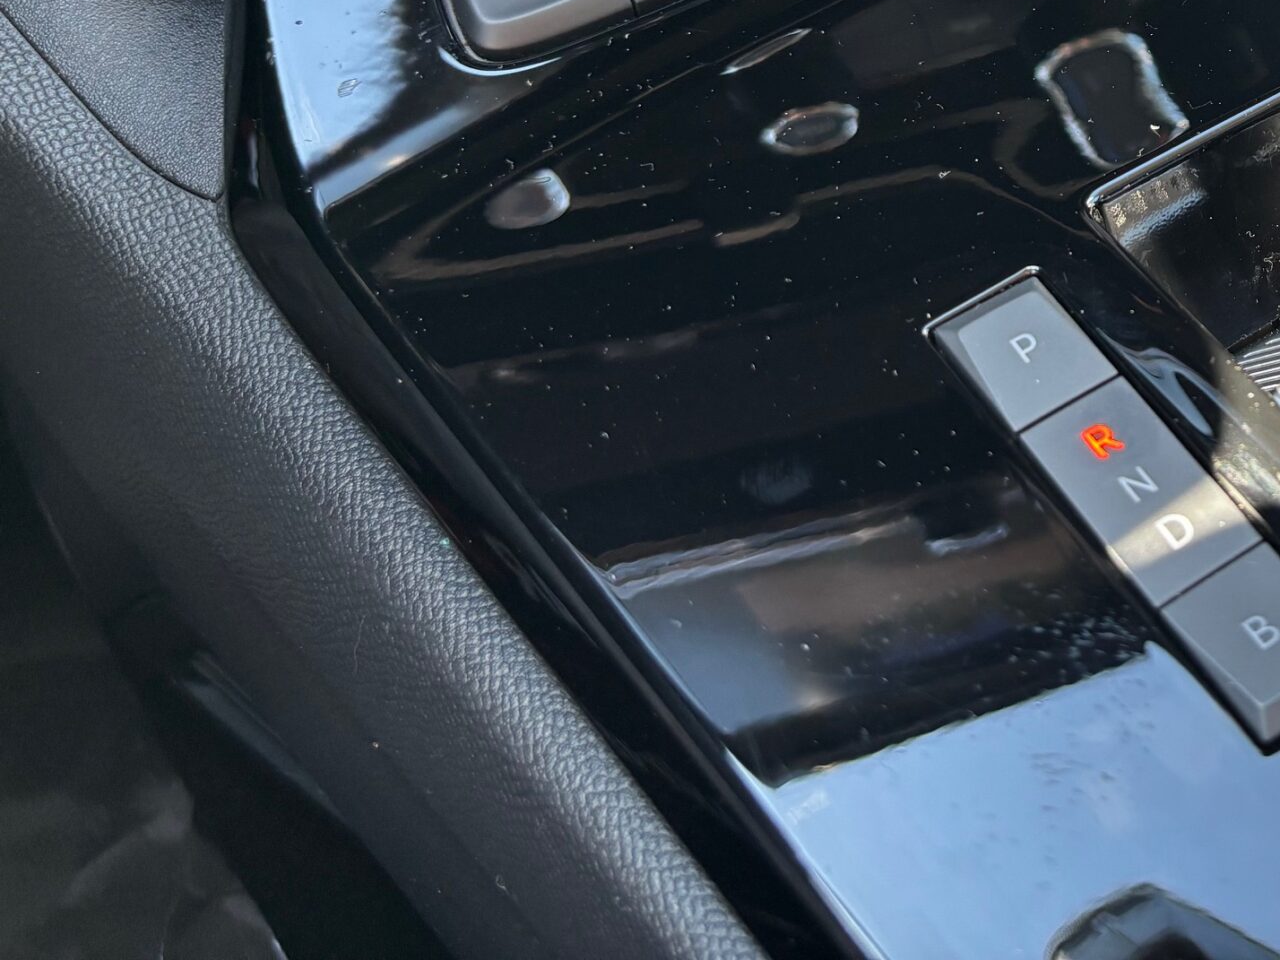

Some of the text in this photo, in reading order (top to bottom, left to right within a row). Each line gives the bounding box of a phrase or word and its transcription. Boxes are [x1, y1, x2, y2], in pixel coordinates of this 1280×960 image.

[1009, 333, 1037, 364] P
[1080, 423, 1126, 460] R
[1117, 466, 1159, 503] N
[1156, 513, 1195, 551] D
[1241, 615, 1280, 651] B
